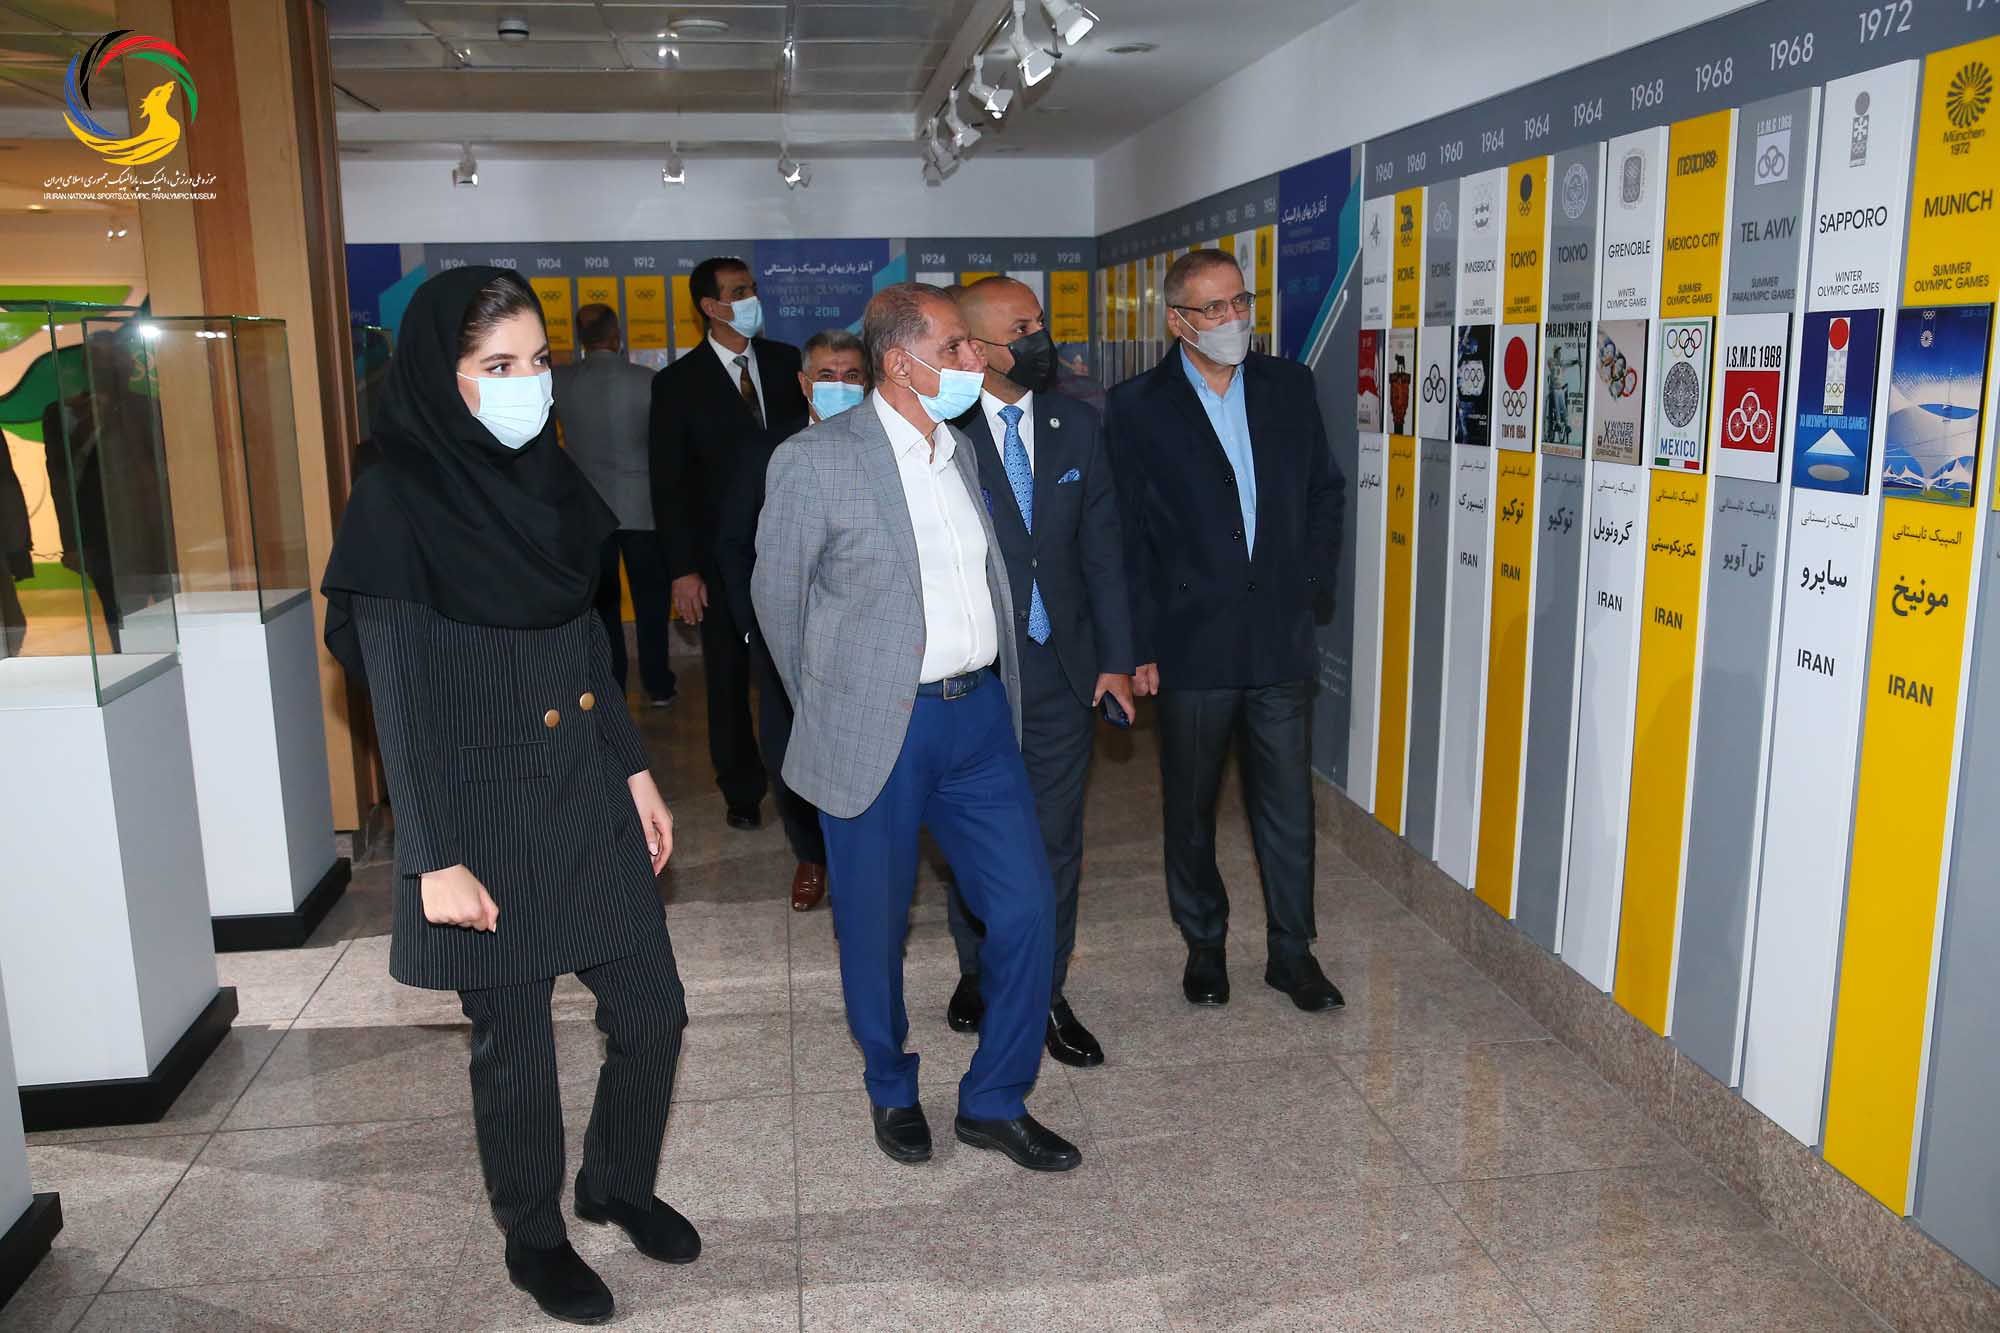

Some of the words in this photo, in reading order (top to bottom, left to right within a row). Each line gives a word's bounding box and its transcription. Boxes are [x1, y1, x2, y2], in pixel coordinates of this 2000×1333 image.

[1406, 151, 1427, 173] 1960
[1439, 140, 1464, 165] 1960
[1481, 127, 1505, 153] 1964
[1524, 113, 1551, 141] 1964
[1573, 97, 1603, 127] 1964
[1630, 79, 1664, 111] 1968
[1695, 57, 1734, 93] 1968
[1769, 32, 1815, 71] 1968
[1858, 0, 1913, 43] 1972
[1942, 128, 1986, 145] München
[1950, 141, 1970, 156] 1972
[1923, 188, 1994, 219] MUNICH
[1741, 220, 1761, 244] TEL
[1763, 215, 1797, 242] AVIV
[1818, 206, 1888, 234] SAPPORO
[1608, 240, 1651, 259] GRENOBLE
[1667, 235, 1700, 252] MEXICO
[1701, 232, 1720, 249] CITY
[490, 258, 517, 270] 1900
[536, 258, 561, 270] 1904
[633, 256, 657, 269] 1912
[920, 253, 946, 265] 1924
[1510, 249, 1538, 270] TOKYO
[1558, 242, 1589, 265] TOKYO
[1463, 259, 1497, 274] INNSBRUCK
[1834, 270, 1863, 284] WINTER
[1932, 261, 1973, 277] SUMMER
[1617, 287, 1636, 298] WINTER
[1817, 286, 1850, 297] OLYMPIC
[1851, 281, 1880, 296] GAMES
[1913, 278, 1952, 293] OLYMPIC
[1954, 274, 1990, 290] GAMES
[1629, 297, 1648, 308] GAMES
[1770, 288, 1796, 301] GAMES
[1544, 320, 1587, 338] PARALYMPIC
[1726, 345, 1757, 368] I.S.M.G
[1759, 345, 1782, 368] 1968
[1660, 437, 1696, 458] MEXICO
[1502, 498, 1524, 525] توکیو
[1547, 507, 1574, 535] توکیو
[1391, 530, 1406, 546] IRAN
[1593, 516, 1633, 545] گرونوبل
[1460, 551, 1478, 568] IRAN
[1722, 543, 1749, 571] آویو
[1748, 551, 1766, 577] تل
[1501, 562, 1521, 581] IRAN
[1800, 559, 1848, 595] ساپرو
[1597, 591, 1623, 612] IRAN
[1891, 575, 1949, 616] مونیخ
[1654, 606, 1683, 630] IRAN
[1796, 648, 1835, 677] IRAN
[1887, 674, 1934, 707] IRAN
